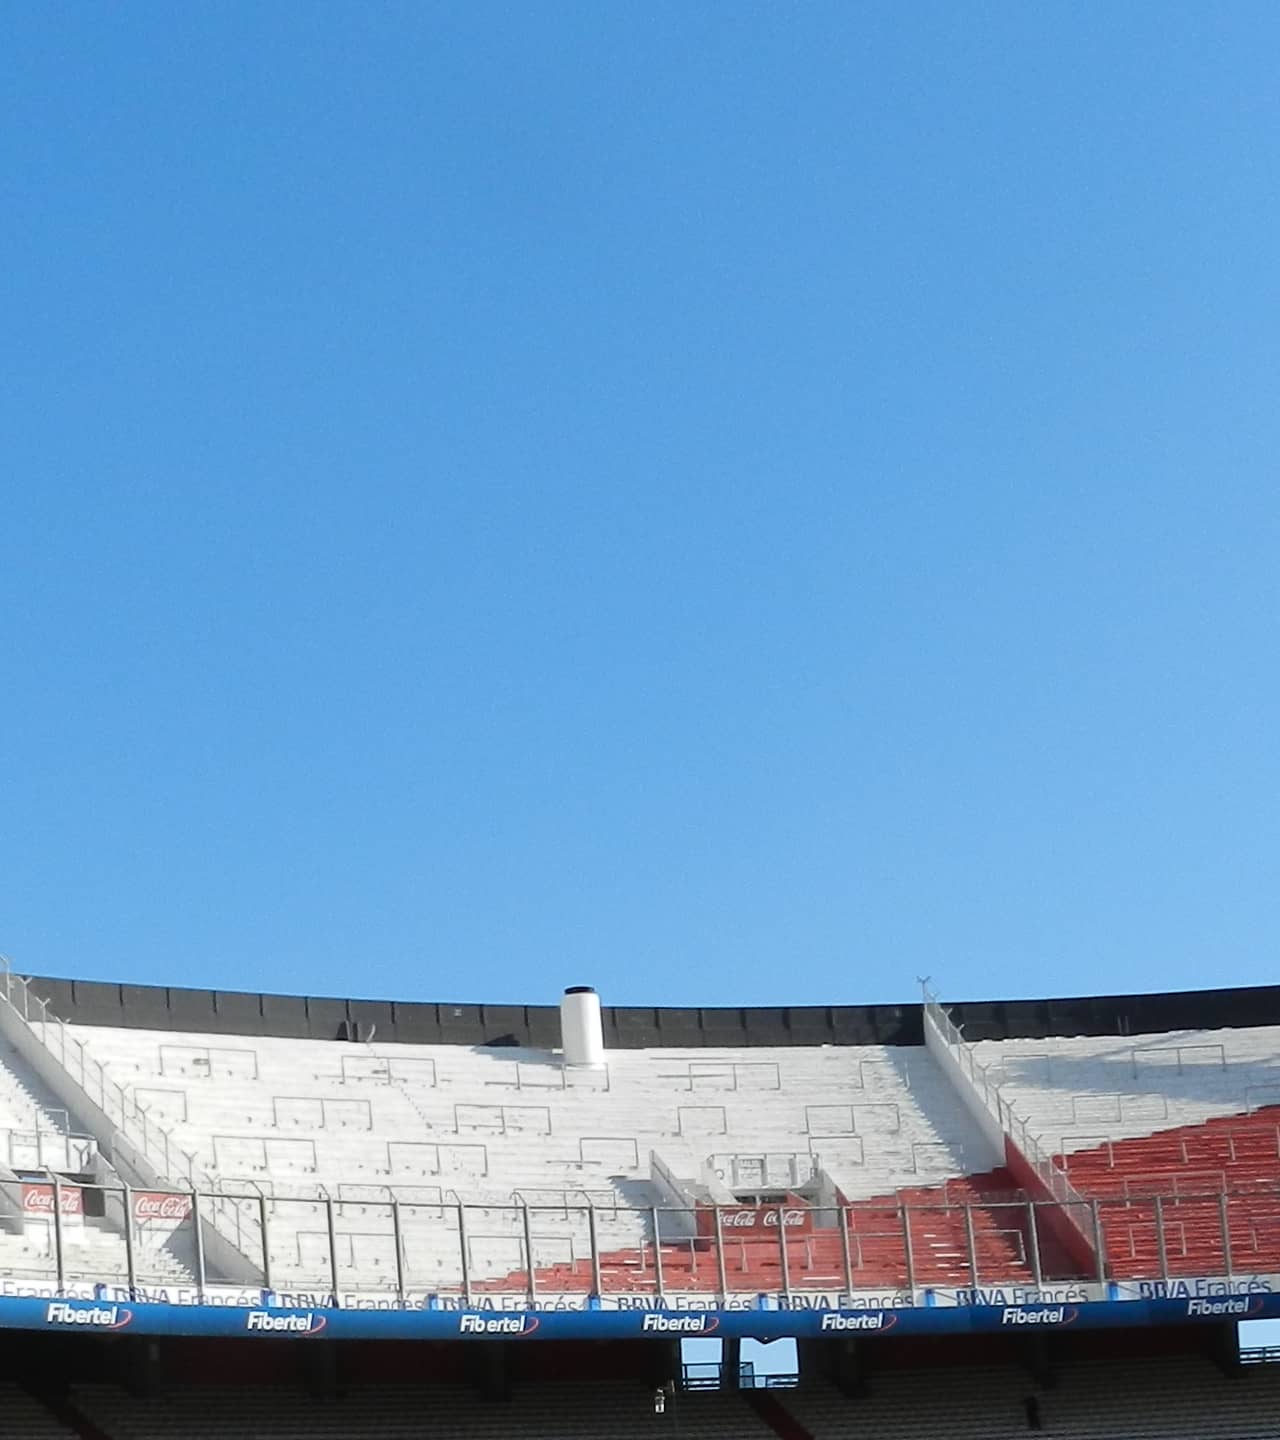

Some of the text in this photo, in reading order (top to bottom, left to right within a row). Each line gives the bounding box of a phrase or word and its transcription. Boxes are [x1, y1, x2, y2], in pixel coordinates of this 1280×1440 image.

[47, 1303, 118, 1325] Fibertel
[1187, 1296, 1249, 1315] Fibertel
[247, 1311, 313, 1331] Fibertel
[460, 1315, 525, 1333] Fibertel
[643, 1314, 706, 1331] Fibertel
[822, 1312, 883, 1330] Fibertel
[1002, 1307, 1064, 1324] Fibertel
